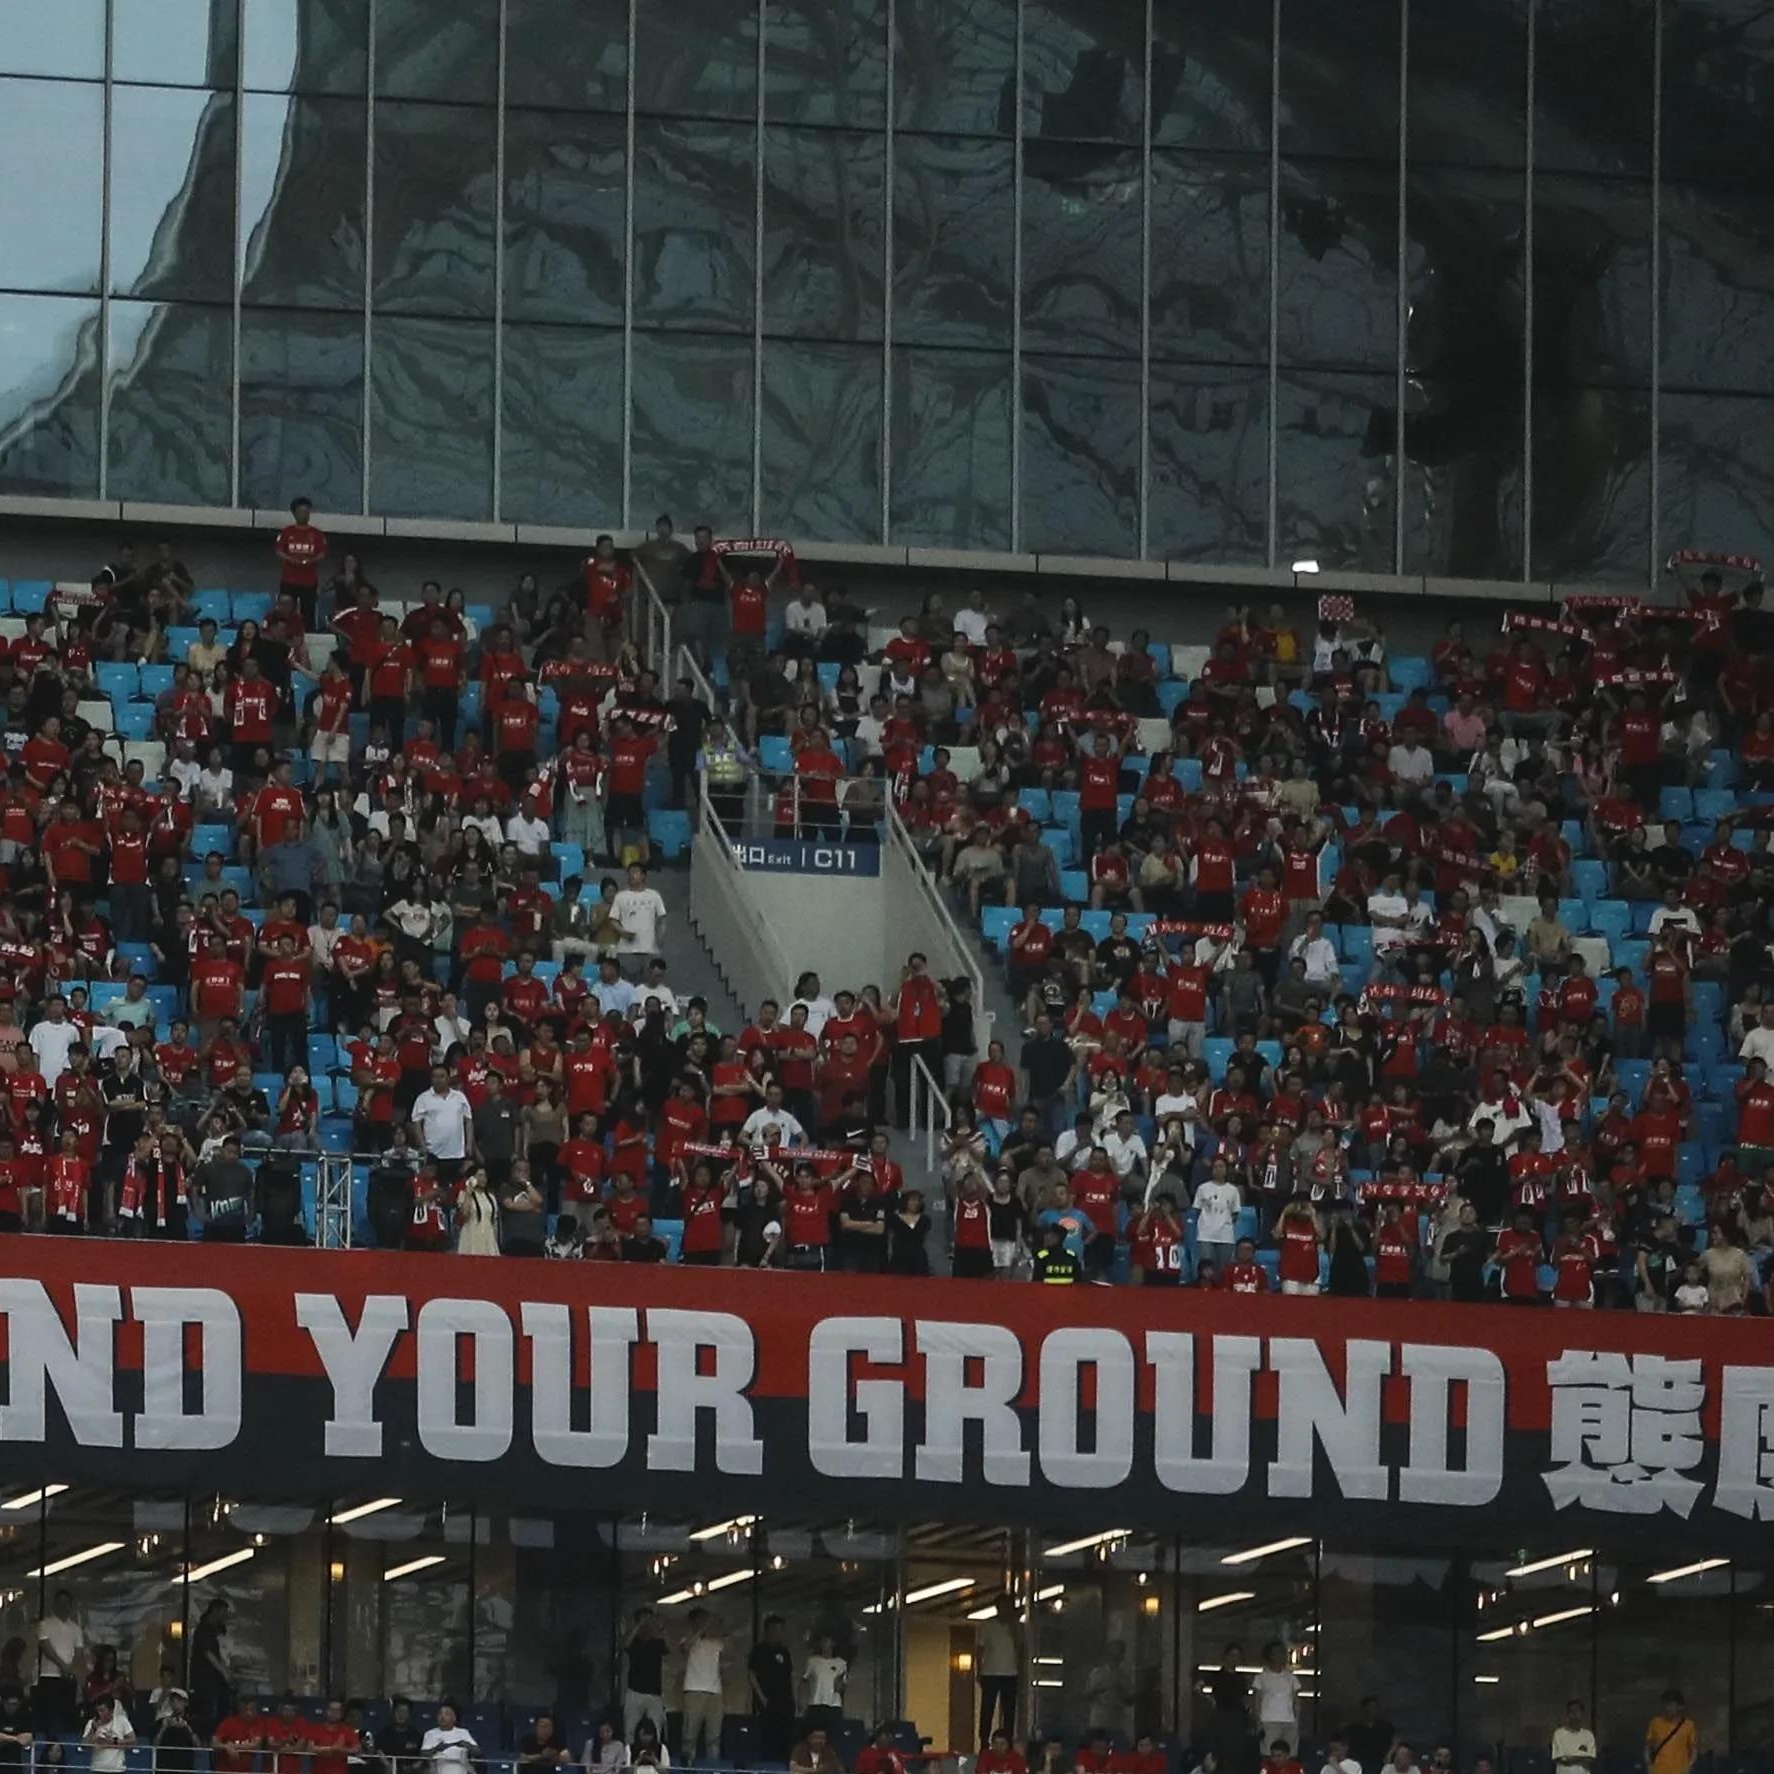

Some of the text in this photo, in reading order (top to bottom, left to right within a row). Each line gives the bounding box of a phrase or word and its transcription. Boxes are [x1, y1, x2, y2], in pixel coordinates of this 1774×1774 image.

[768, 854, 791, 865] Exit
[815, 850, 855, 870] C11
[295, 1293, 764, 1477] YOUR
[808, 1315, 1506, 1507] GROUND
